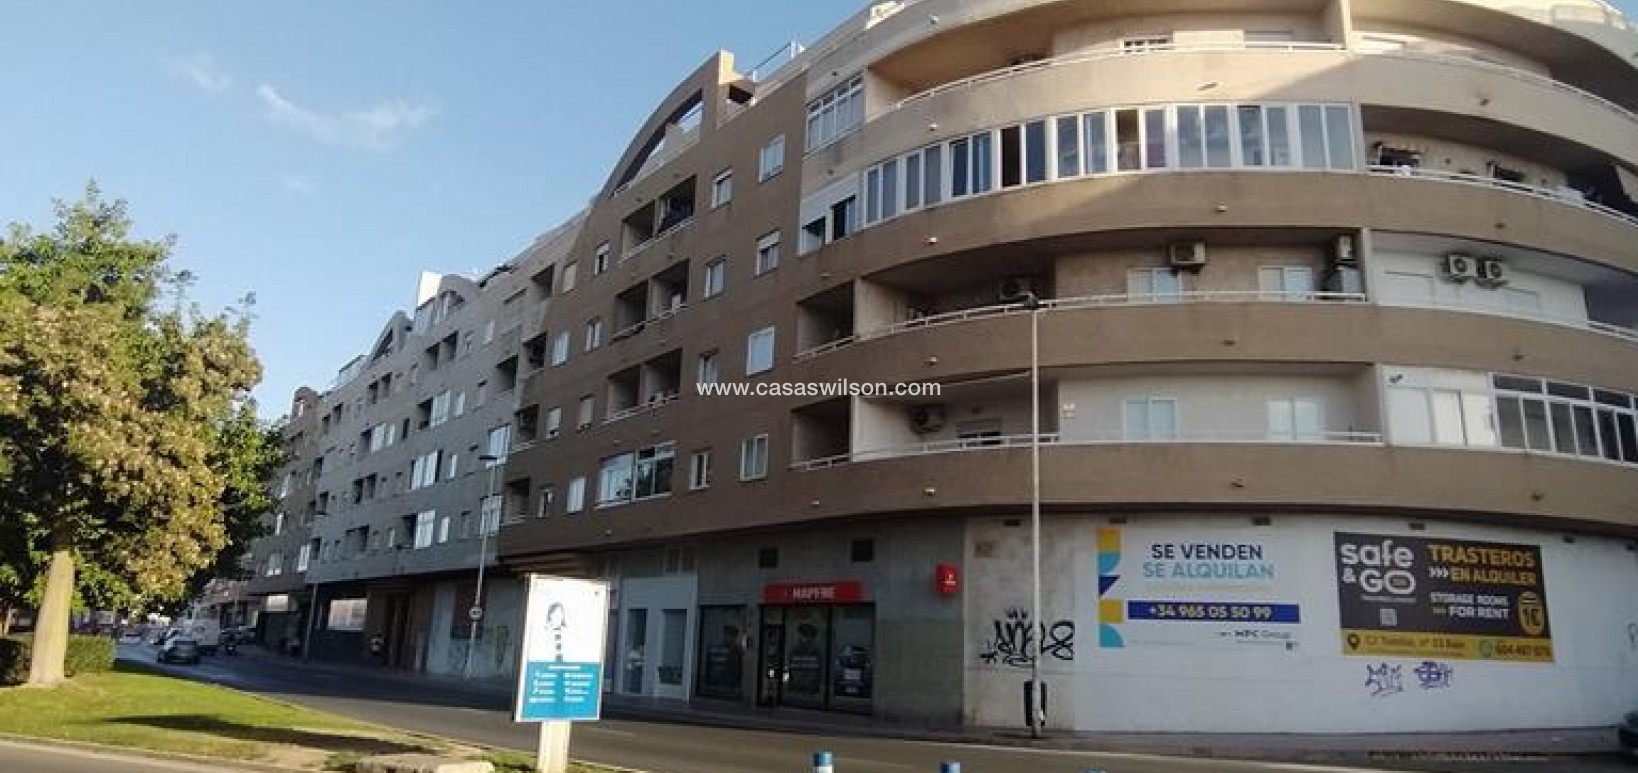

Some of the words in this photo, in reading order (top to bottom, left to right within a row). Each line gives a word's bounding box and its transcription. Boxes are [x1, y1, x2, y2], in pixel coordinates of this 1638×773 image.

[1152, 544, 1174, 560] SE
[1181, 544, 1263, 560] VENDEN
[1340, 540, 1414, 567] safe
[1428, 545, 1536, 567] TRASTEROS
[1143, 562, 1166, 578] SE
[1173, 562, 1275, 579] ALQUILAN
[1451, 567, 1471, 582] EN
[1473, 569, 1537, 585] ALQUILER
[1150, 605, 1175, 617] +34
[1253, 607, 1272, 619] 99
[1449, 606, 1475, 618] FOR
[1477, 607, 1509, 618] RENT
